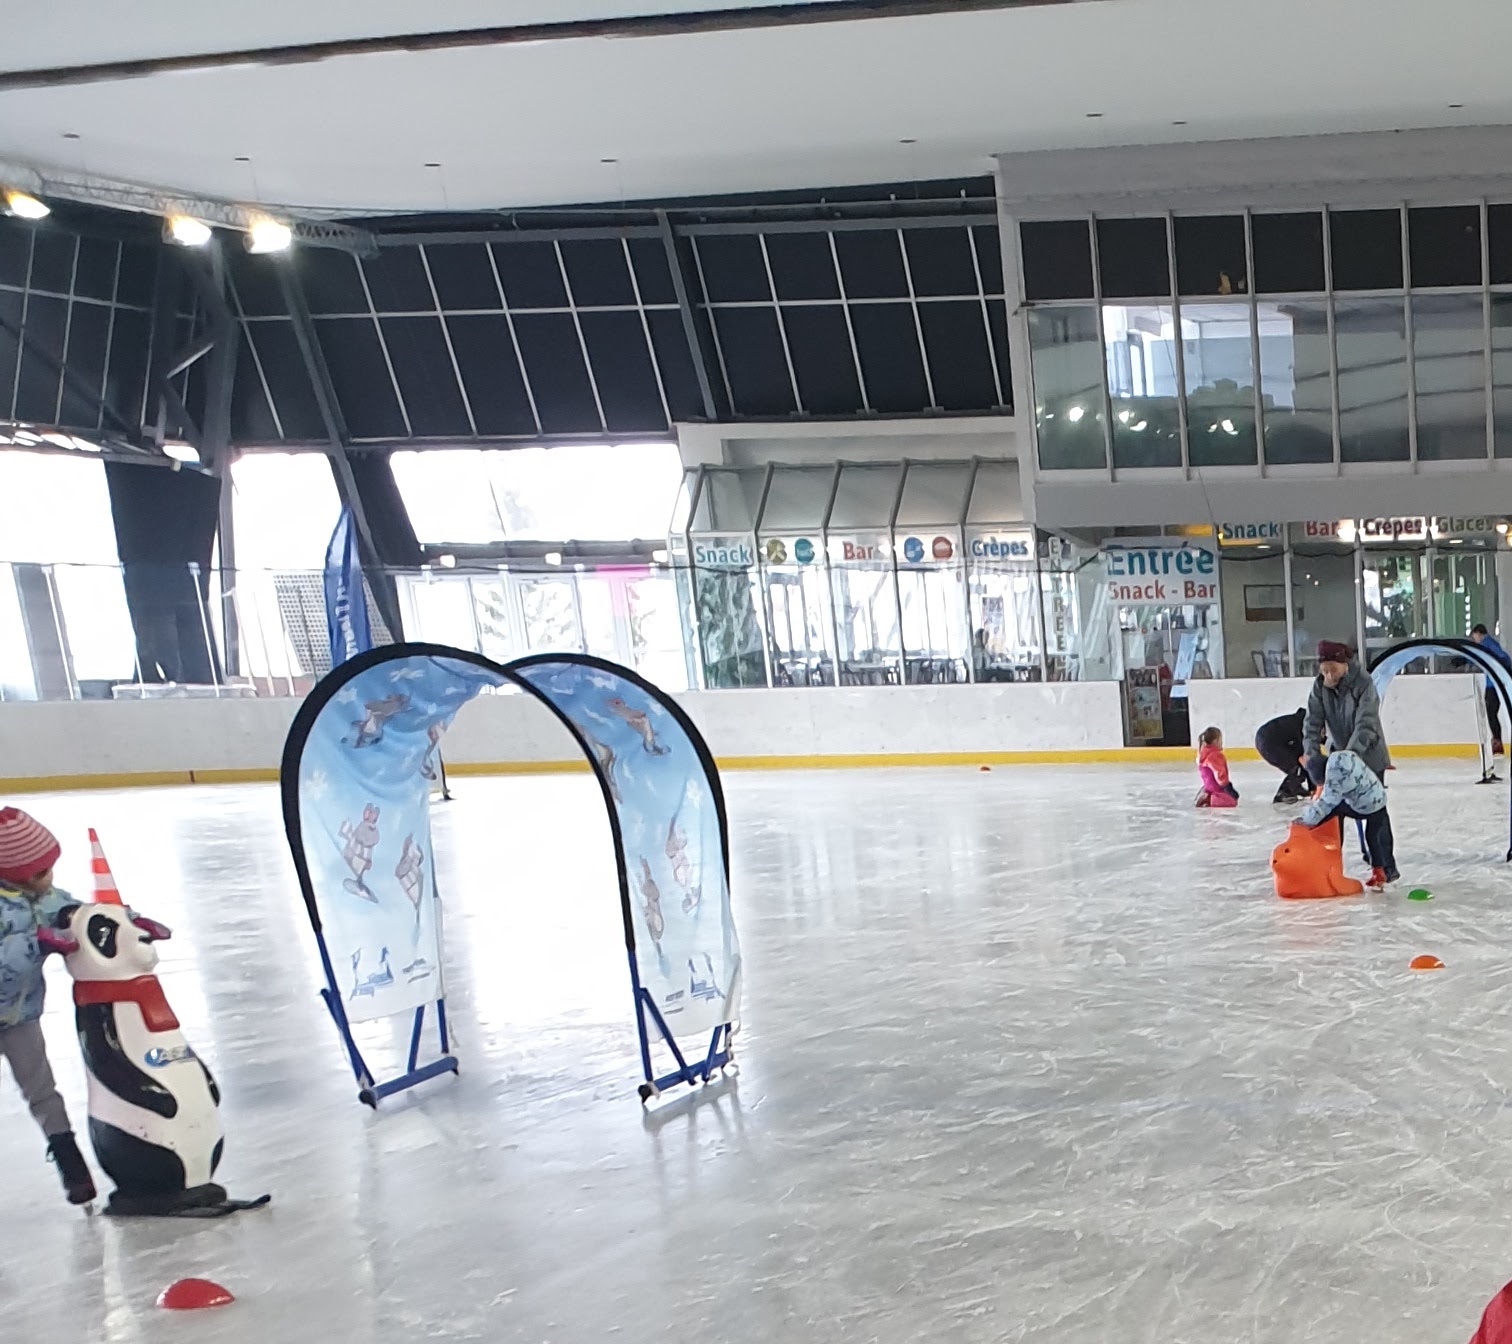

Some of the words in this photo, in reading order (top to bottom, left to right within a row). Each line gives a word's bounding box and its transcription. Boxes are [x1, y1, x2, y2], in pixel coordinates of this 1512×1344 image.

[1223, 521, 1279, 539] Snack
[1306, 520, 1340, 536] Bar
[696, 545, 750, 563] Snack
[843, 541, 874, 560] Bar
[1107, 541, 1214, 576] Entrée
[1108, 580, 1165, 600] Snack
[1184, 581, 1216, 599] Bar
